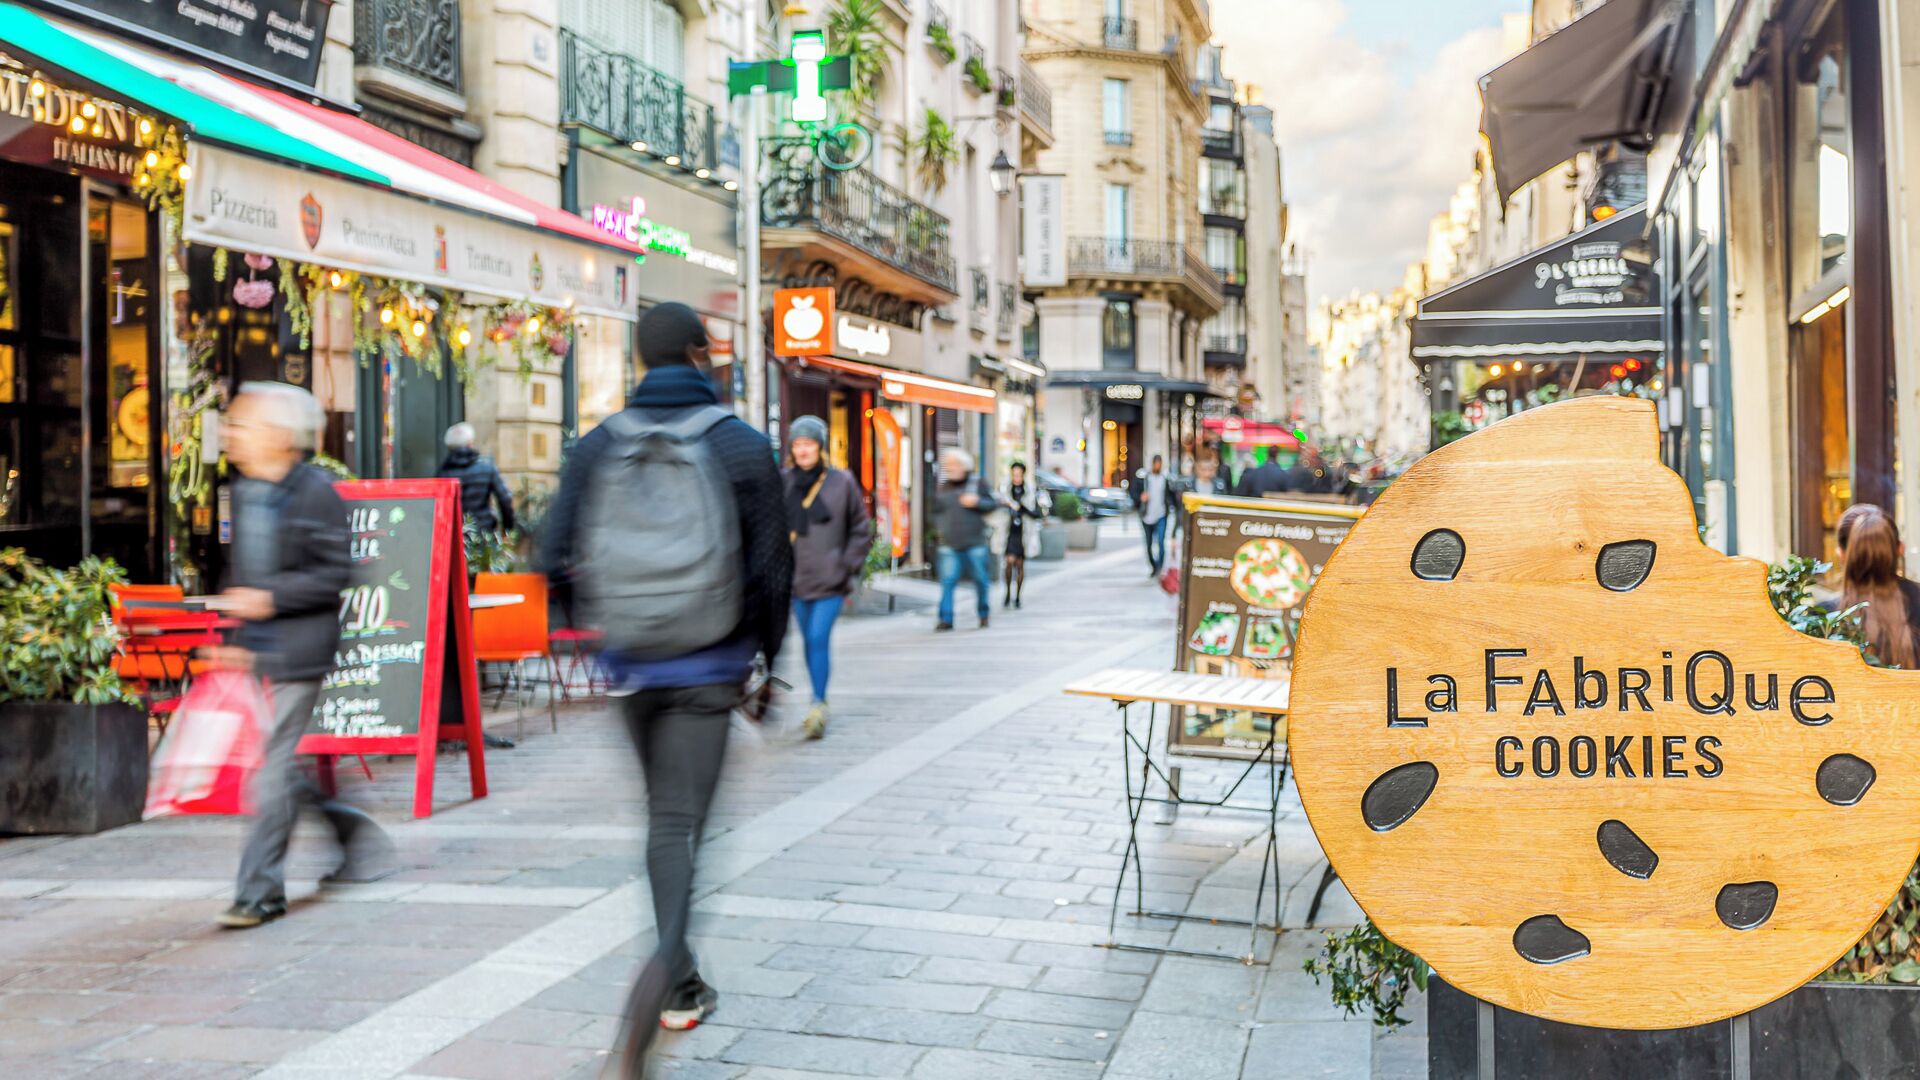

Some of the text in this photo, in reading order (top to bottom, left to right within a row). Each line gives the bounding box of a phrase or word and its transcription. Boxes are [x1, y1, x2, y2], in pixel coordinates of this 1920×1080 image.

[210, 187, 277, 229] Pizzeria
[1274, 523, 1314, 540] Freddo
[1386, 666, 1458, 728] La
[1495, 735, 1724, 779] COOKIES
